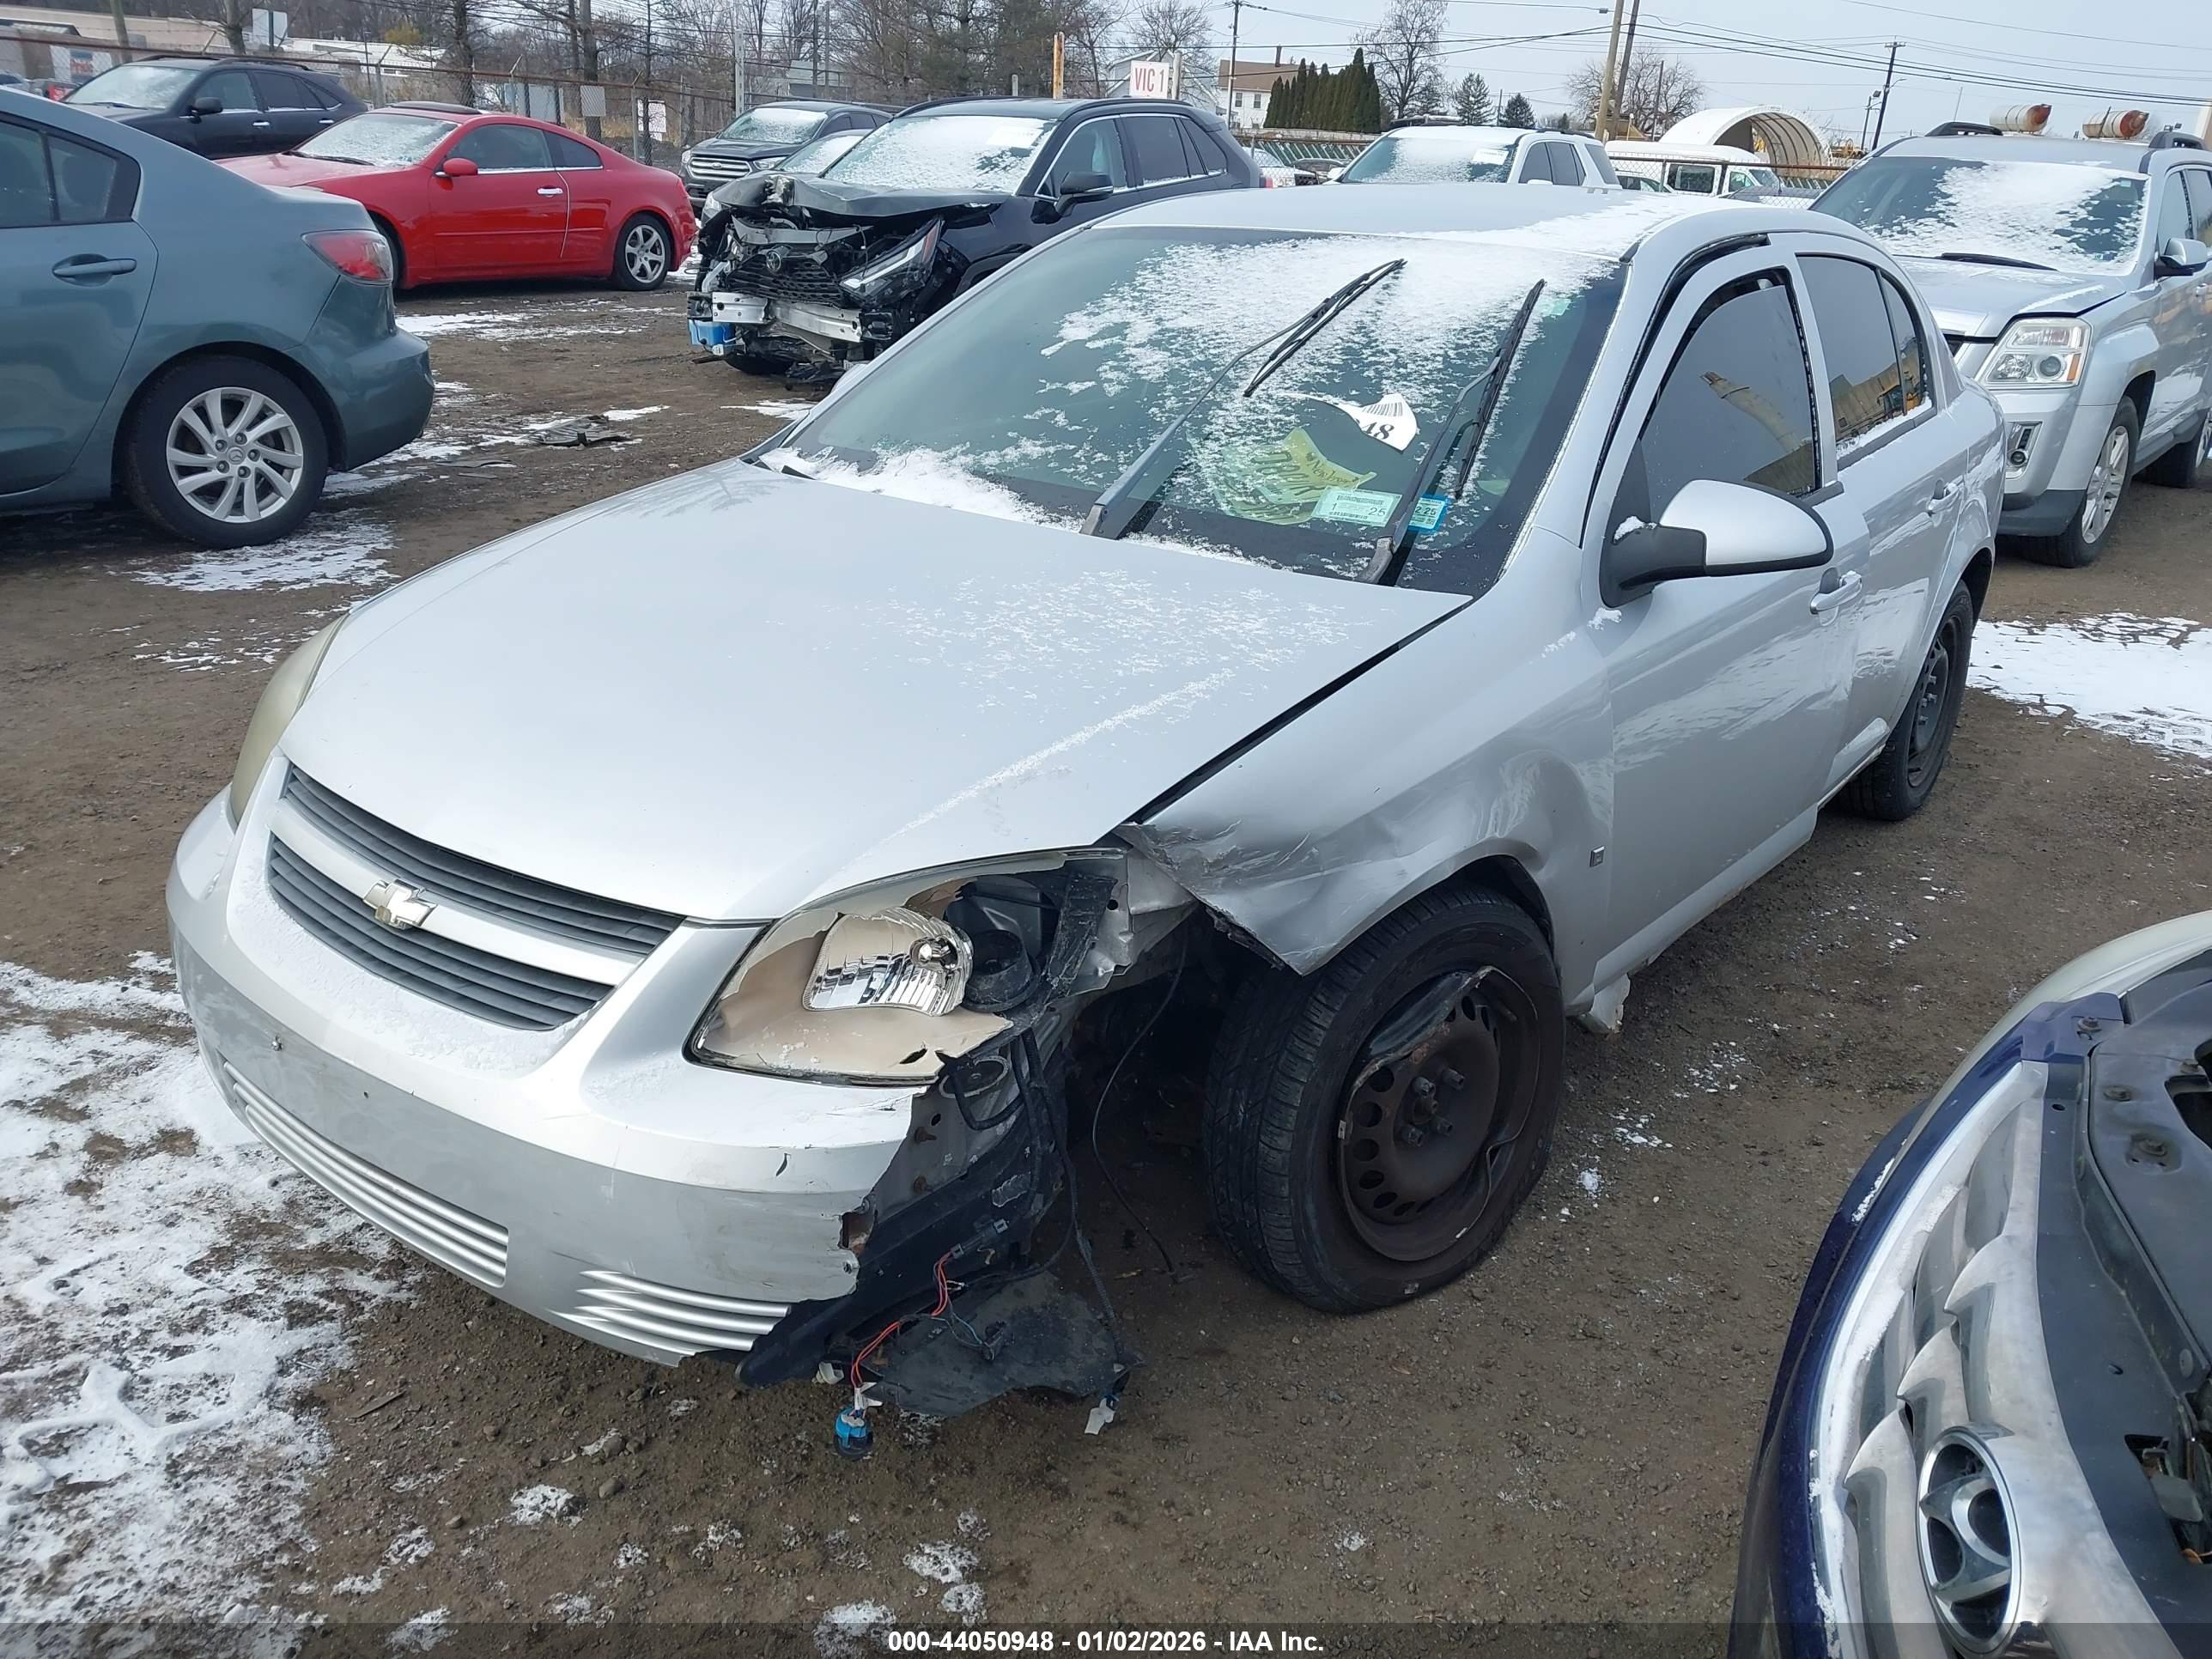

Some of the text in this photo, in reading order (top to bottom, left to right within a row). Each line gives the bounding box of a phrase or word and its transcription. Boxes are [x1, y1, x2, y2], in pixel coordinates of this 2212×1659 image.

[1134, 68, 1164, 92] VIC 1
[1368, 507, 1387, 517] 25
[1424, 506, 1437, 516] 25
